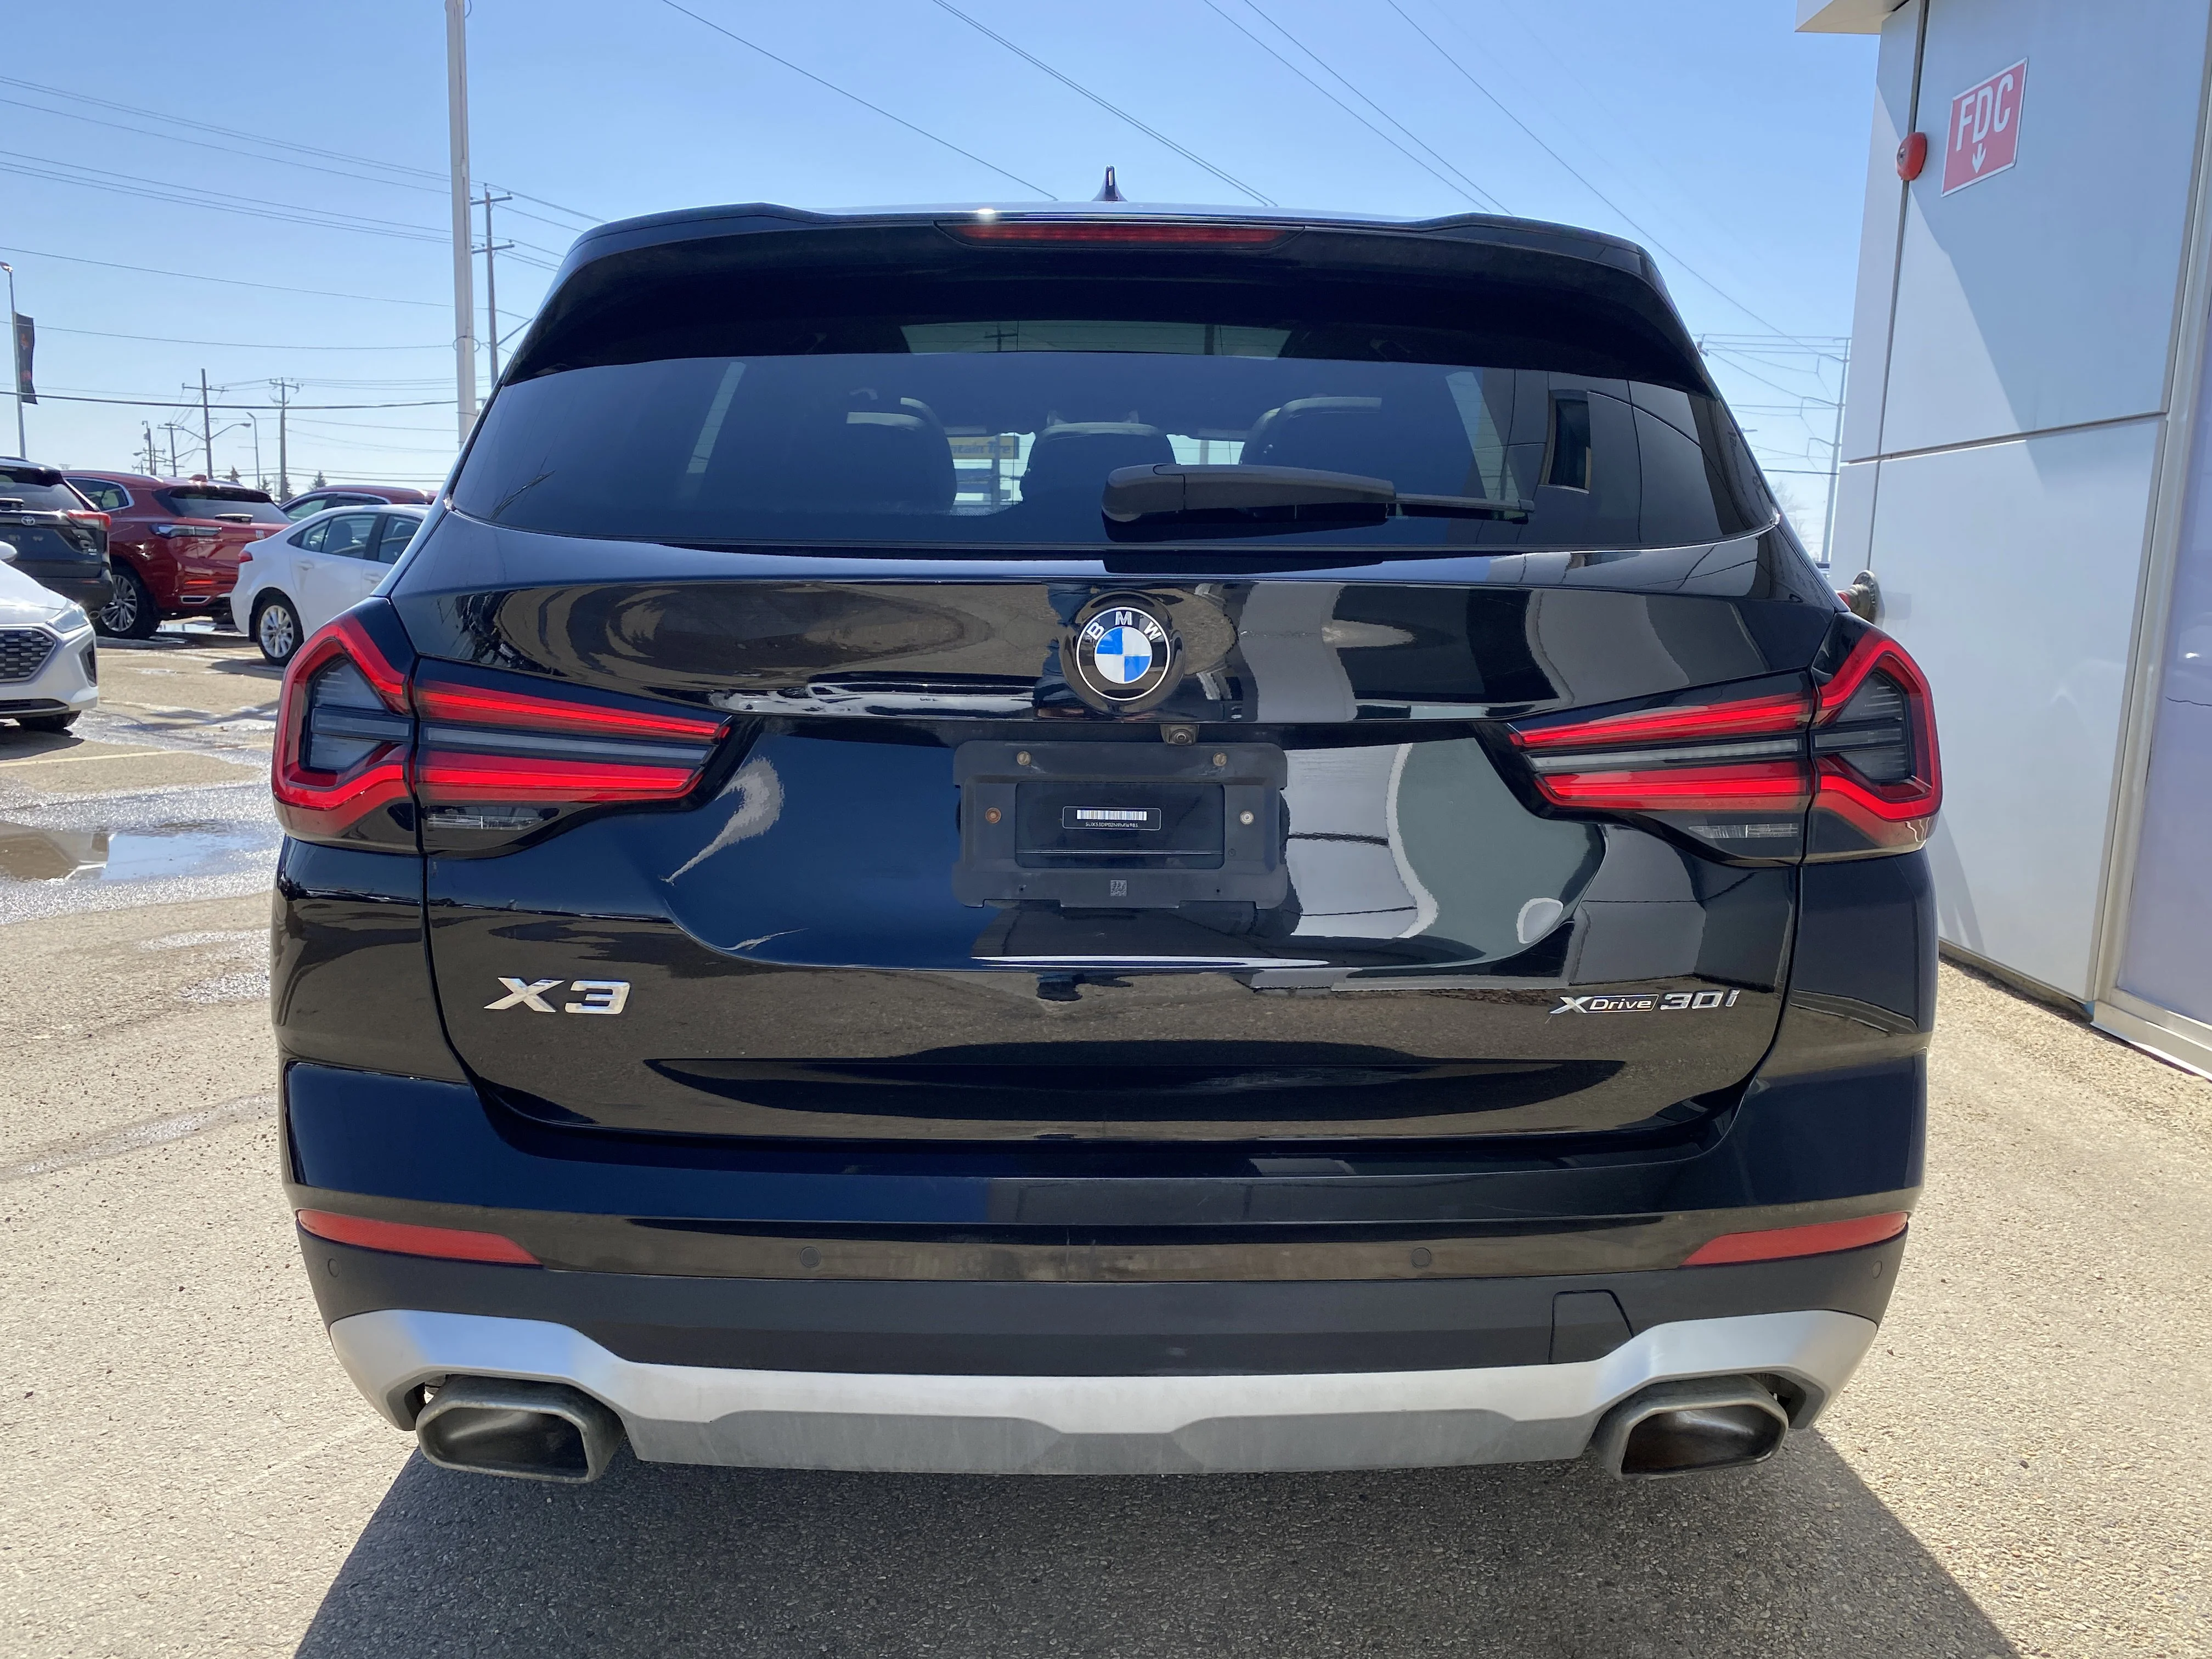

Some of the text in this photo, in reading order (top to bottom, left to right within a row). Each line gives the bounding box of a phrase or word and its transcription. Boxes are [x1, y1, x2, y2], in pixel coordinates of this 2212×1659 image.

[1956, 73, 2013, 152] FDC
[1086, 611, 1161, 641] BMW
[483, 977, 631, 1014] X3
[1660, 989, 1741, 1011] 30i
